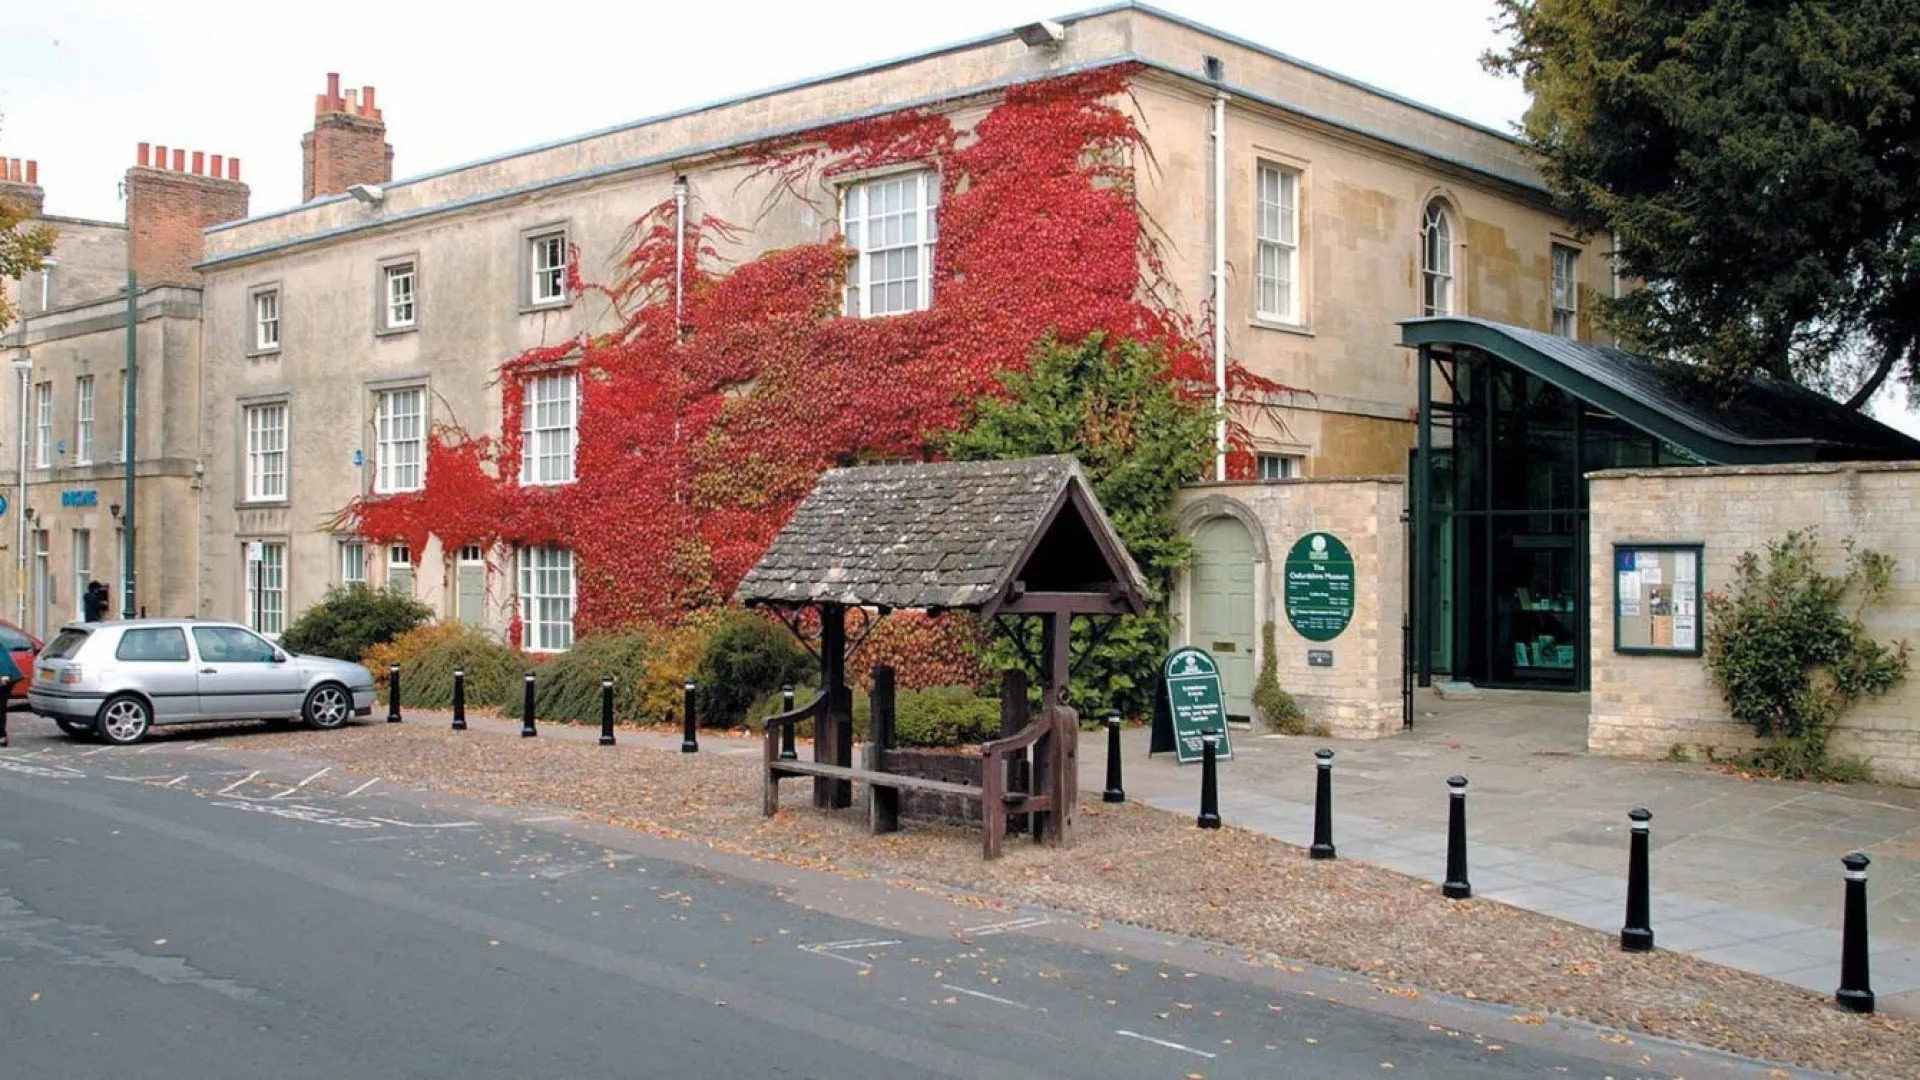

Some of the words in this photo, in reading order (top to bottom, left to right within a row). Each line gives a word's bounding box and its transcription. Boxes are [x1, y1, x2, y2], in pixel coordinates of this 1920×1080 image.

[1313, 563, 1325, 571] The
[1289, 571, 1324, 580] Oxfordshire
[1324, 572, 1349, 580] Museum
